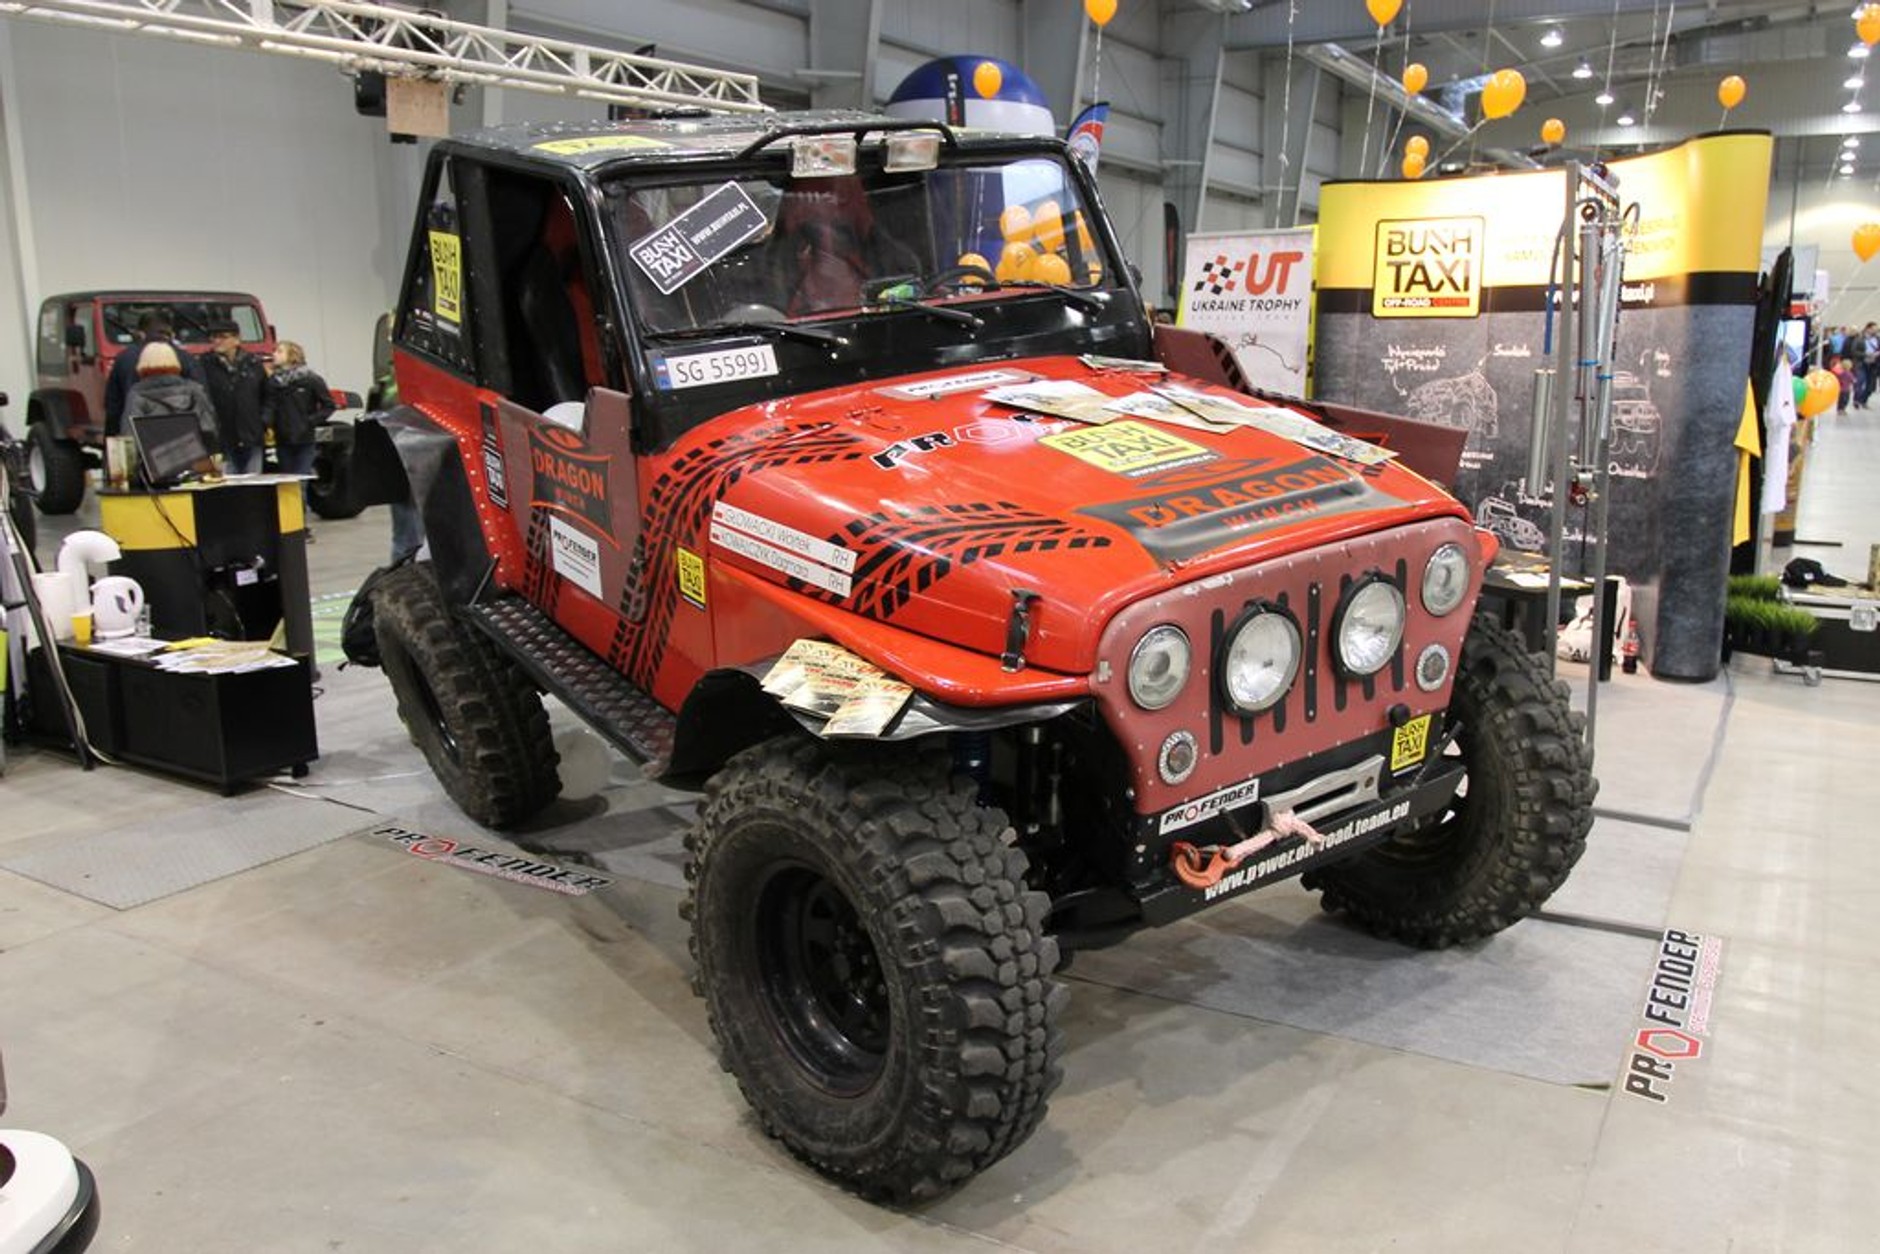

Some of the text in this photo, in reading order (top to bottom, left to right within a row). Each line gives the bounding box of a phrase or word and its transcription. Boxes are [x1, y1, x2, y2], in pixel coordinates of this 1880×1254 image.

[637, 230, 681, 266] BUSH
[1387, 228, 1472, 255] BUSH
[649, 243, 694, 278] TAXI
[1245, 251, 1304, 295] UT
[1386, 260, 1471, 293] TAXI
[436, 265, 459, 300] TAXI
[1191, 299, 1302, 312] UKRAINE TROPHY
[675, 360, 704, 383] SG
[1058, 424, 1145, 449] BUSH
[1080, 434, 1178, 461] TAXI
[532, 447, 605, 499] DRAGON
[1129, 463, 1347, 529] DRAGON
[1221, 498, 1321, 532] WINCH
[682, 566, 702, 591] TAXI
[1397, 734, 1423, 756] TAXI
[1163, 783, 1255, 826] PROFENDER
[374, 827, 610, 889] PROFENDER
[1624, 929, 1701, 1102] PROFENDER
